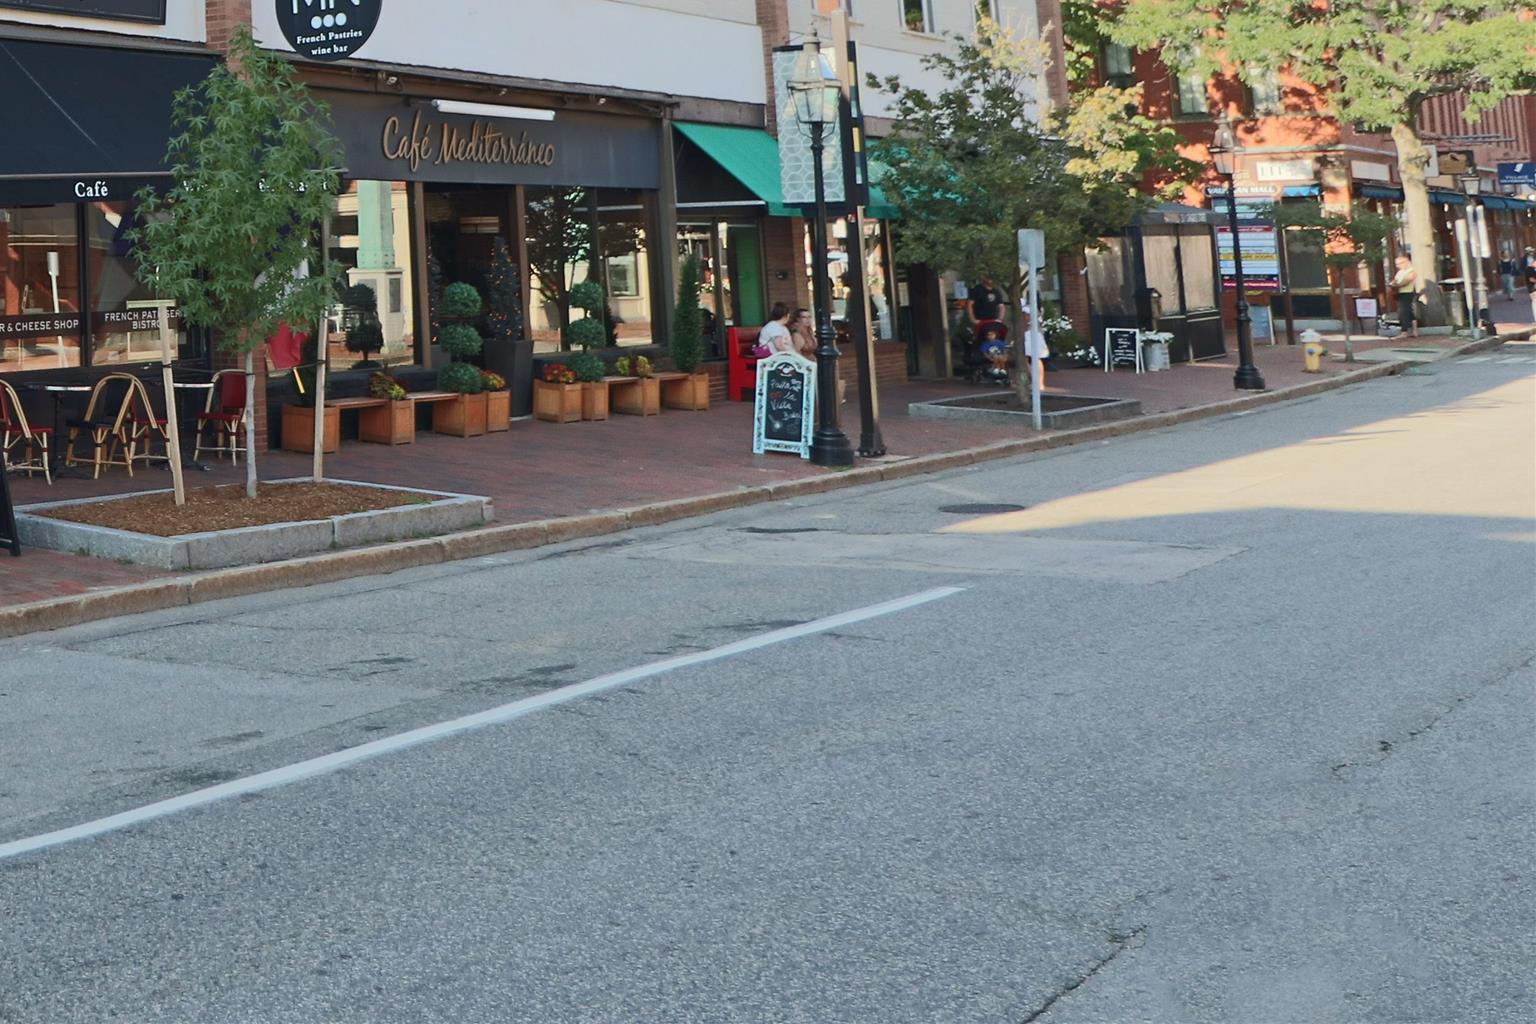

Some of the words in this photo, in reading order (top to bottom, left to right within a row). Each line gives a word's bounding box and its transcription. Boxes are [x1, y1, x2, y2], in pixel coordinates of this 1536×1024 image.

[296, 32, 326, 45] French
[328, 29, 363, 41] Pastries
[311, 46, 331, 56] wine
[333, 44, 348, 54] bar
[383, 109, 432, 173] Café
[433, 121, 556, 168] Mediterráneo
[74, 181, 109, 200] Café
[104, 311, 139, 322] FRENCH
[7, 323, 13, 332] &
[15, 320, 52, 331] CHEESE
[54, 318, 80, 330] SHOP
